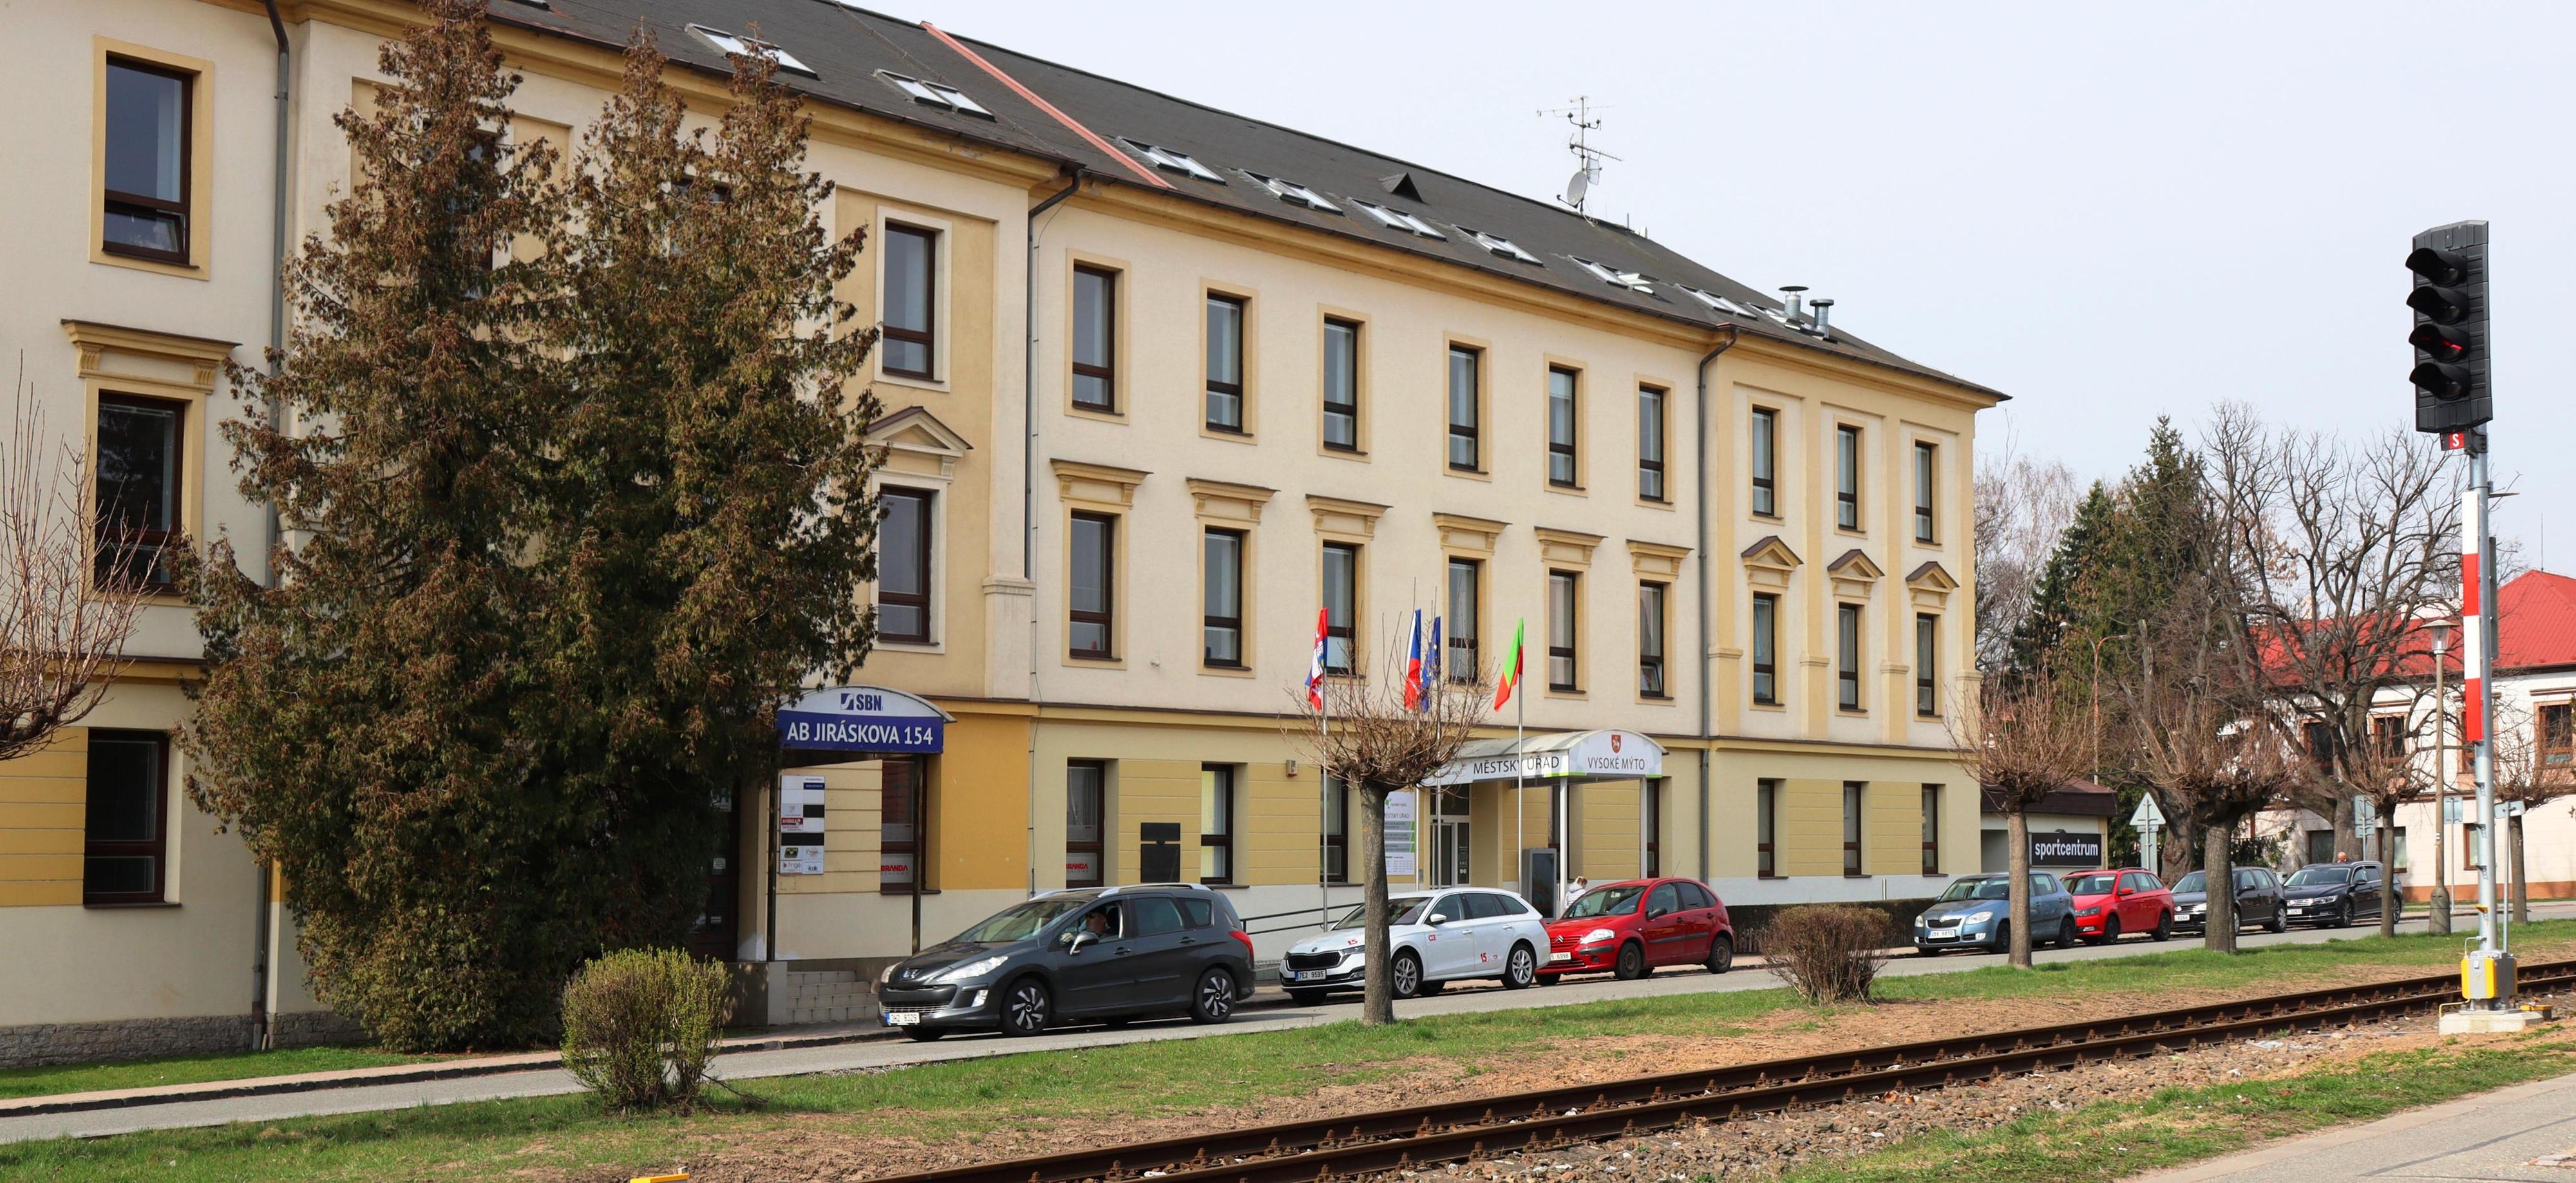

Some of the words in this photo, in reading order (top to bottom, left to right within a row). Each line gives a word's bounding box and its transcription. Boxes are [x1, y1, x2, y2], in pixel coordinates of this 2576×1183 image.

[2452, 433, 2459, 447] S
[856, 695, 882, 711] SBN
[787, 722, 810, 741] AB
[814, 720, 900, 744] JIRÁSKOVA
[904, 727, 933, 745] 154
[1527, 755, 1559, 770] ÚŘAD
[1587, 756, 1619, 770] VYSOKÉ
[1622, 757, 1645, 770] MÝTO
[2035, 838, 2098, 860] sportcentrum
